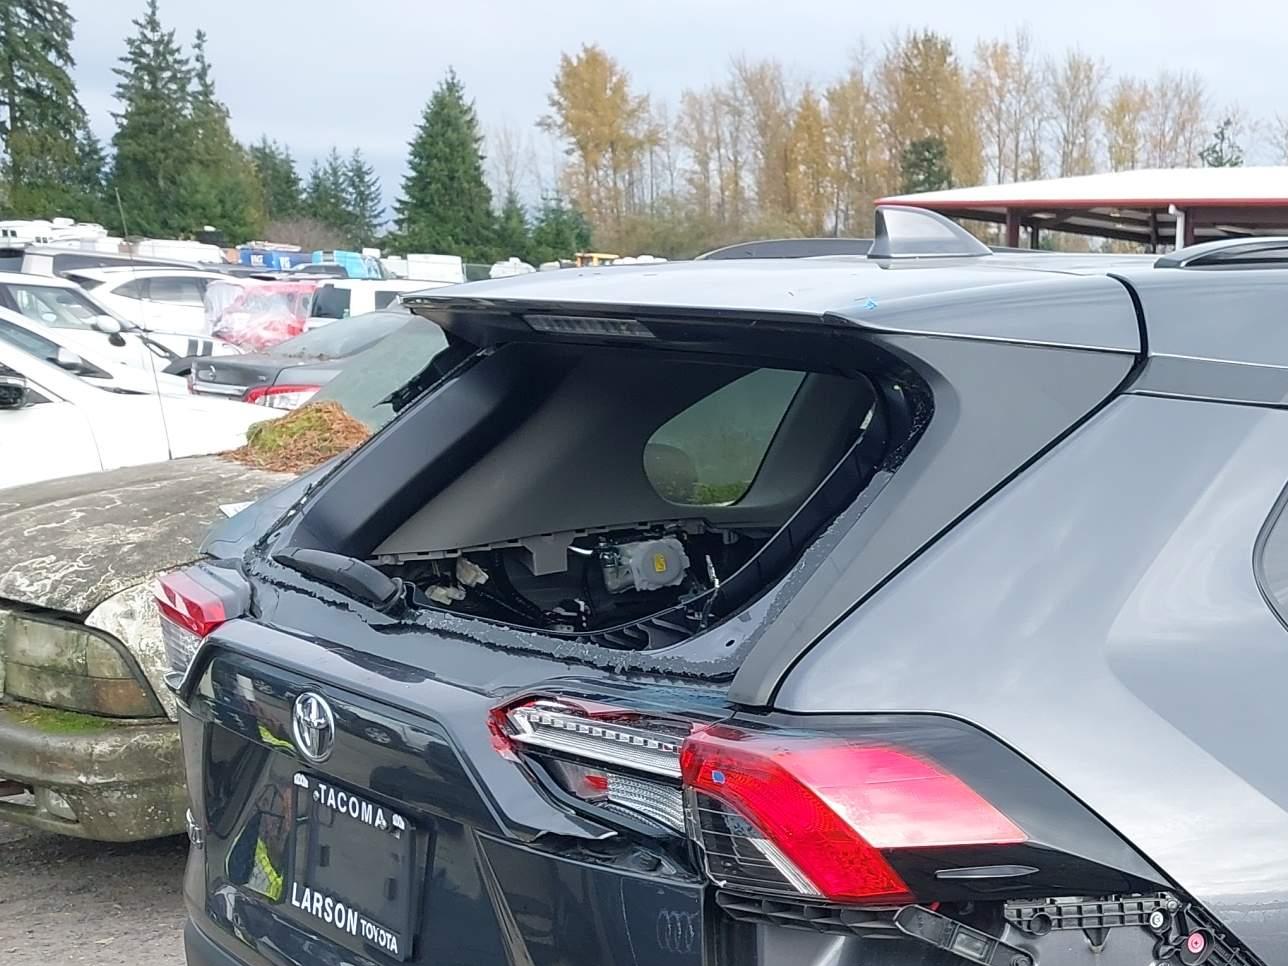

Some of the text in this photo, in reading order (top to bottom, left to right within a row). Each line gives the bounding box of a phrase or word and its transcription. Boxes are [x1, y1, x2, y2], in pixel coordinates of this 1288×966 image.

[319, 784, 387, 828] TACOMA
[291, 882, 399, 954] LARSON TOYOTA
